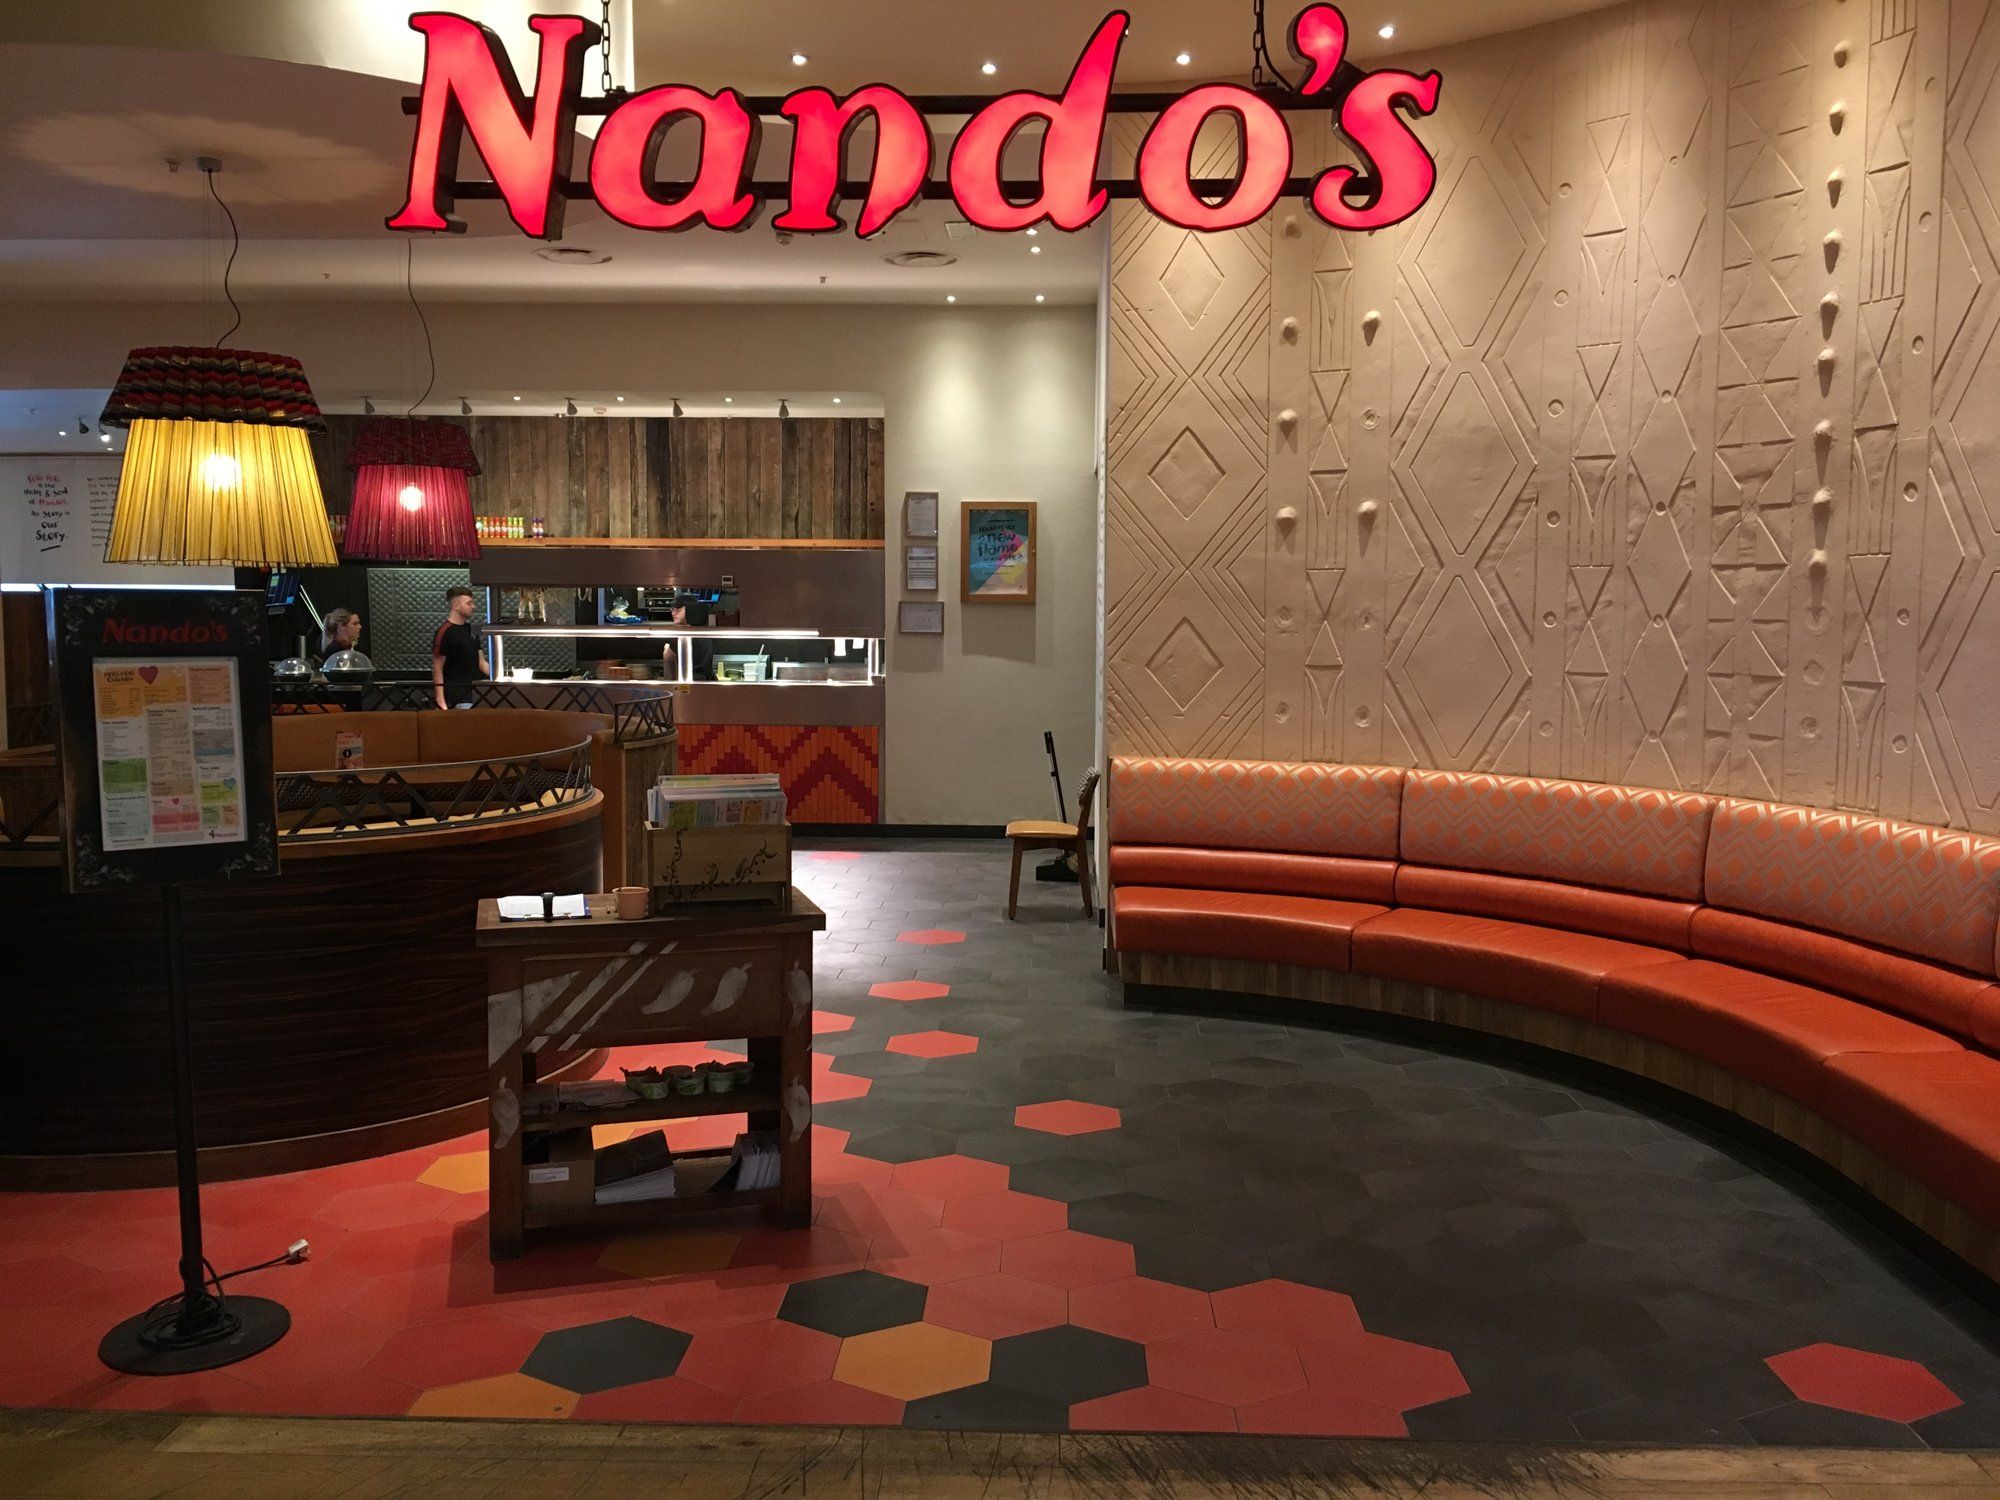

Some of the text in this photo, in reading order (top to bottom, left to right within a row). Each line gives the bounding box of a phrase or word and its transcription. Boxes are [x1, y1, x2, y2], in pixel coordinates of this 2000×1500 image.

[386, 2, 1441, 239] Nando's
[987, 533, 1016, 543] new
[977, 543, 1018, 557] flame
[103, 616, 229, 644] Nando's
